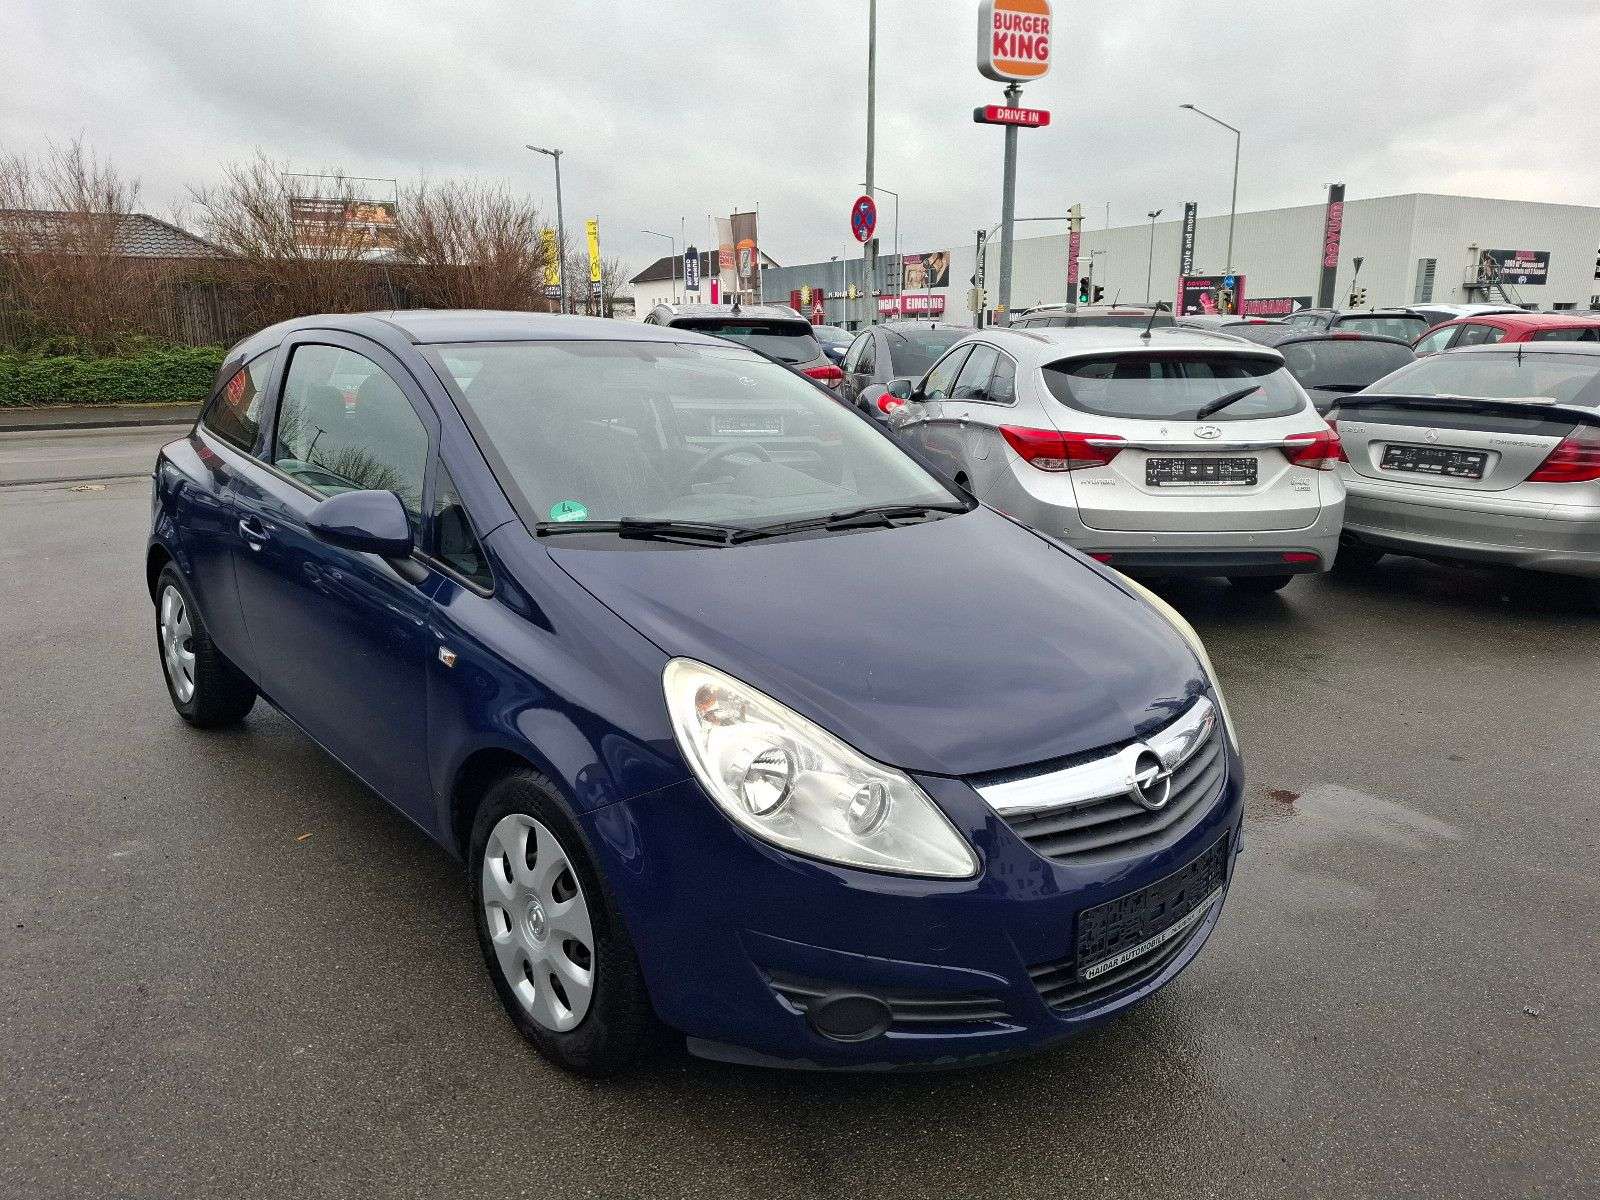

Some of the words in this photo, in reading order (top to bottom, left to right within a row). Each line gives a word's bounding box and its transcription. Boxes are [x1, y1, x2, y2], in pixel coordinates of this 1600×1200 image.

[993, 12, 1050, 34] BURGER
[993, 32, 1049, 60] KING
[997, 108, 1027, 121] DRIVE
[1029, 110, 1039, 122] IN
[1089, 958, 1118, 978] HAIDAR
[1121, 935, 1167, 965] AUTOMOBILE
